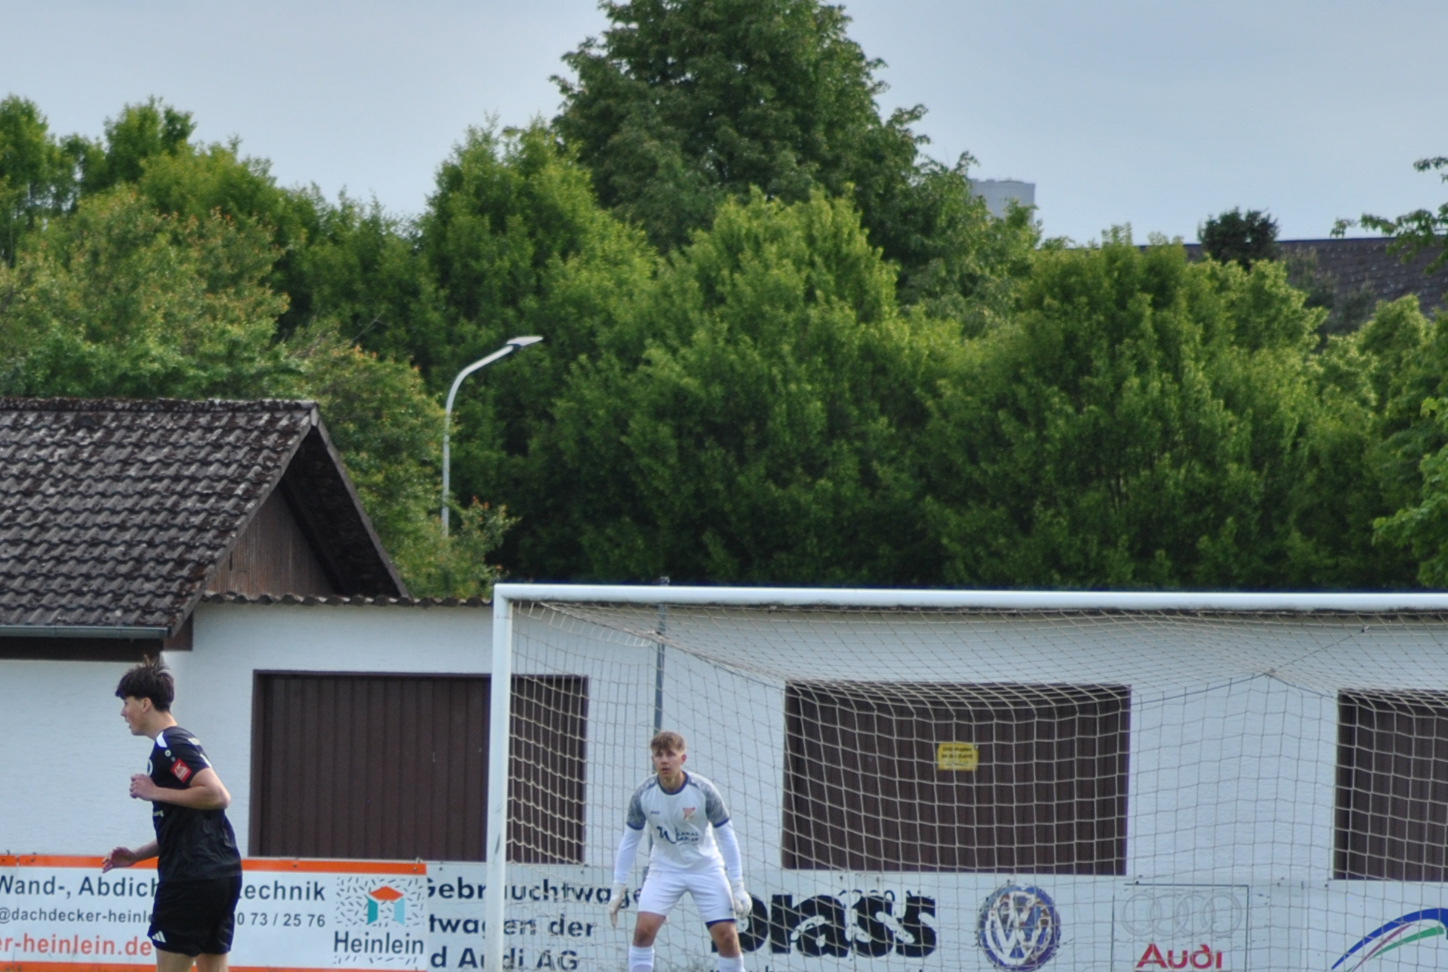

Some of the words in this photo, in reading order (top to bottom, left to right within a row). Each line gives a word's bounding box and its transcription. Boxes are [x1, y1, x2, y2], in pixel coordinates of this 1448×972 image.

[250, 912, 268, 926] 73
[283, 913, 302, 927] 25
[308, 914, 326, 928] 76
[547, 914, 595, 937] der
[333, 930, 424, 955] Heinlein
[457, 948, 525, 969] Adi
[536, 949, 580, 971] AG
[1136, 943, 1223, 969] Audi
